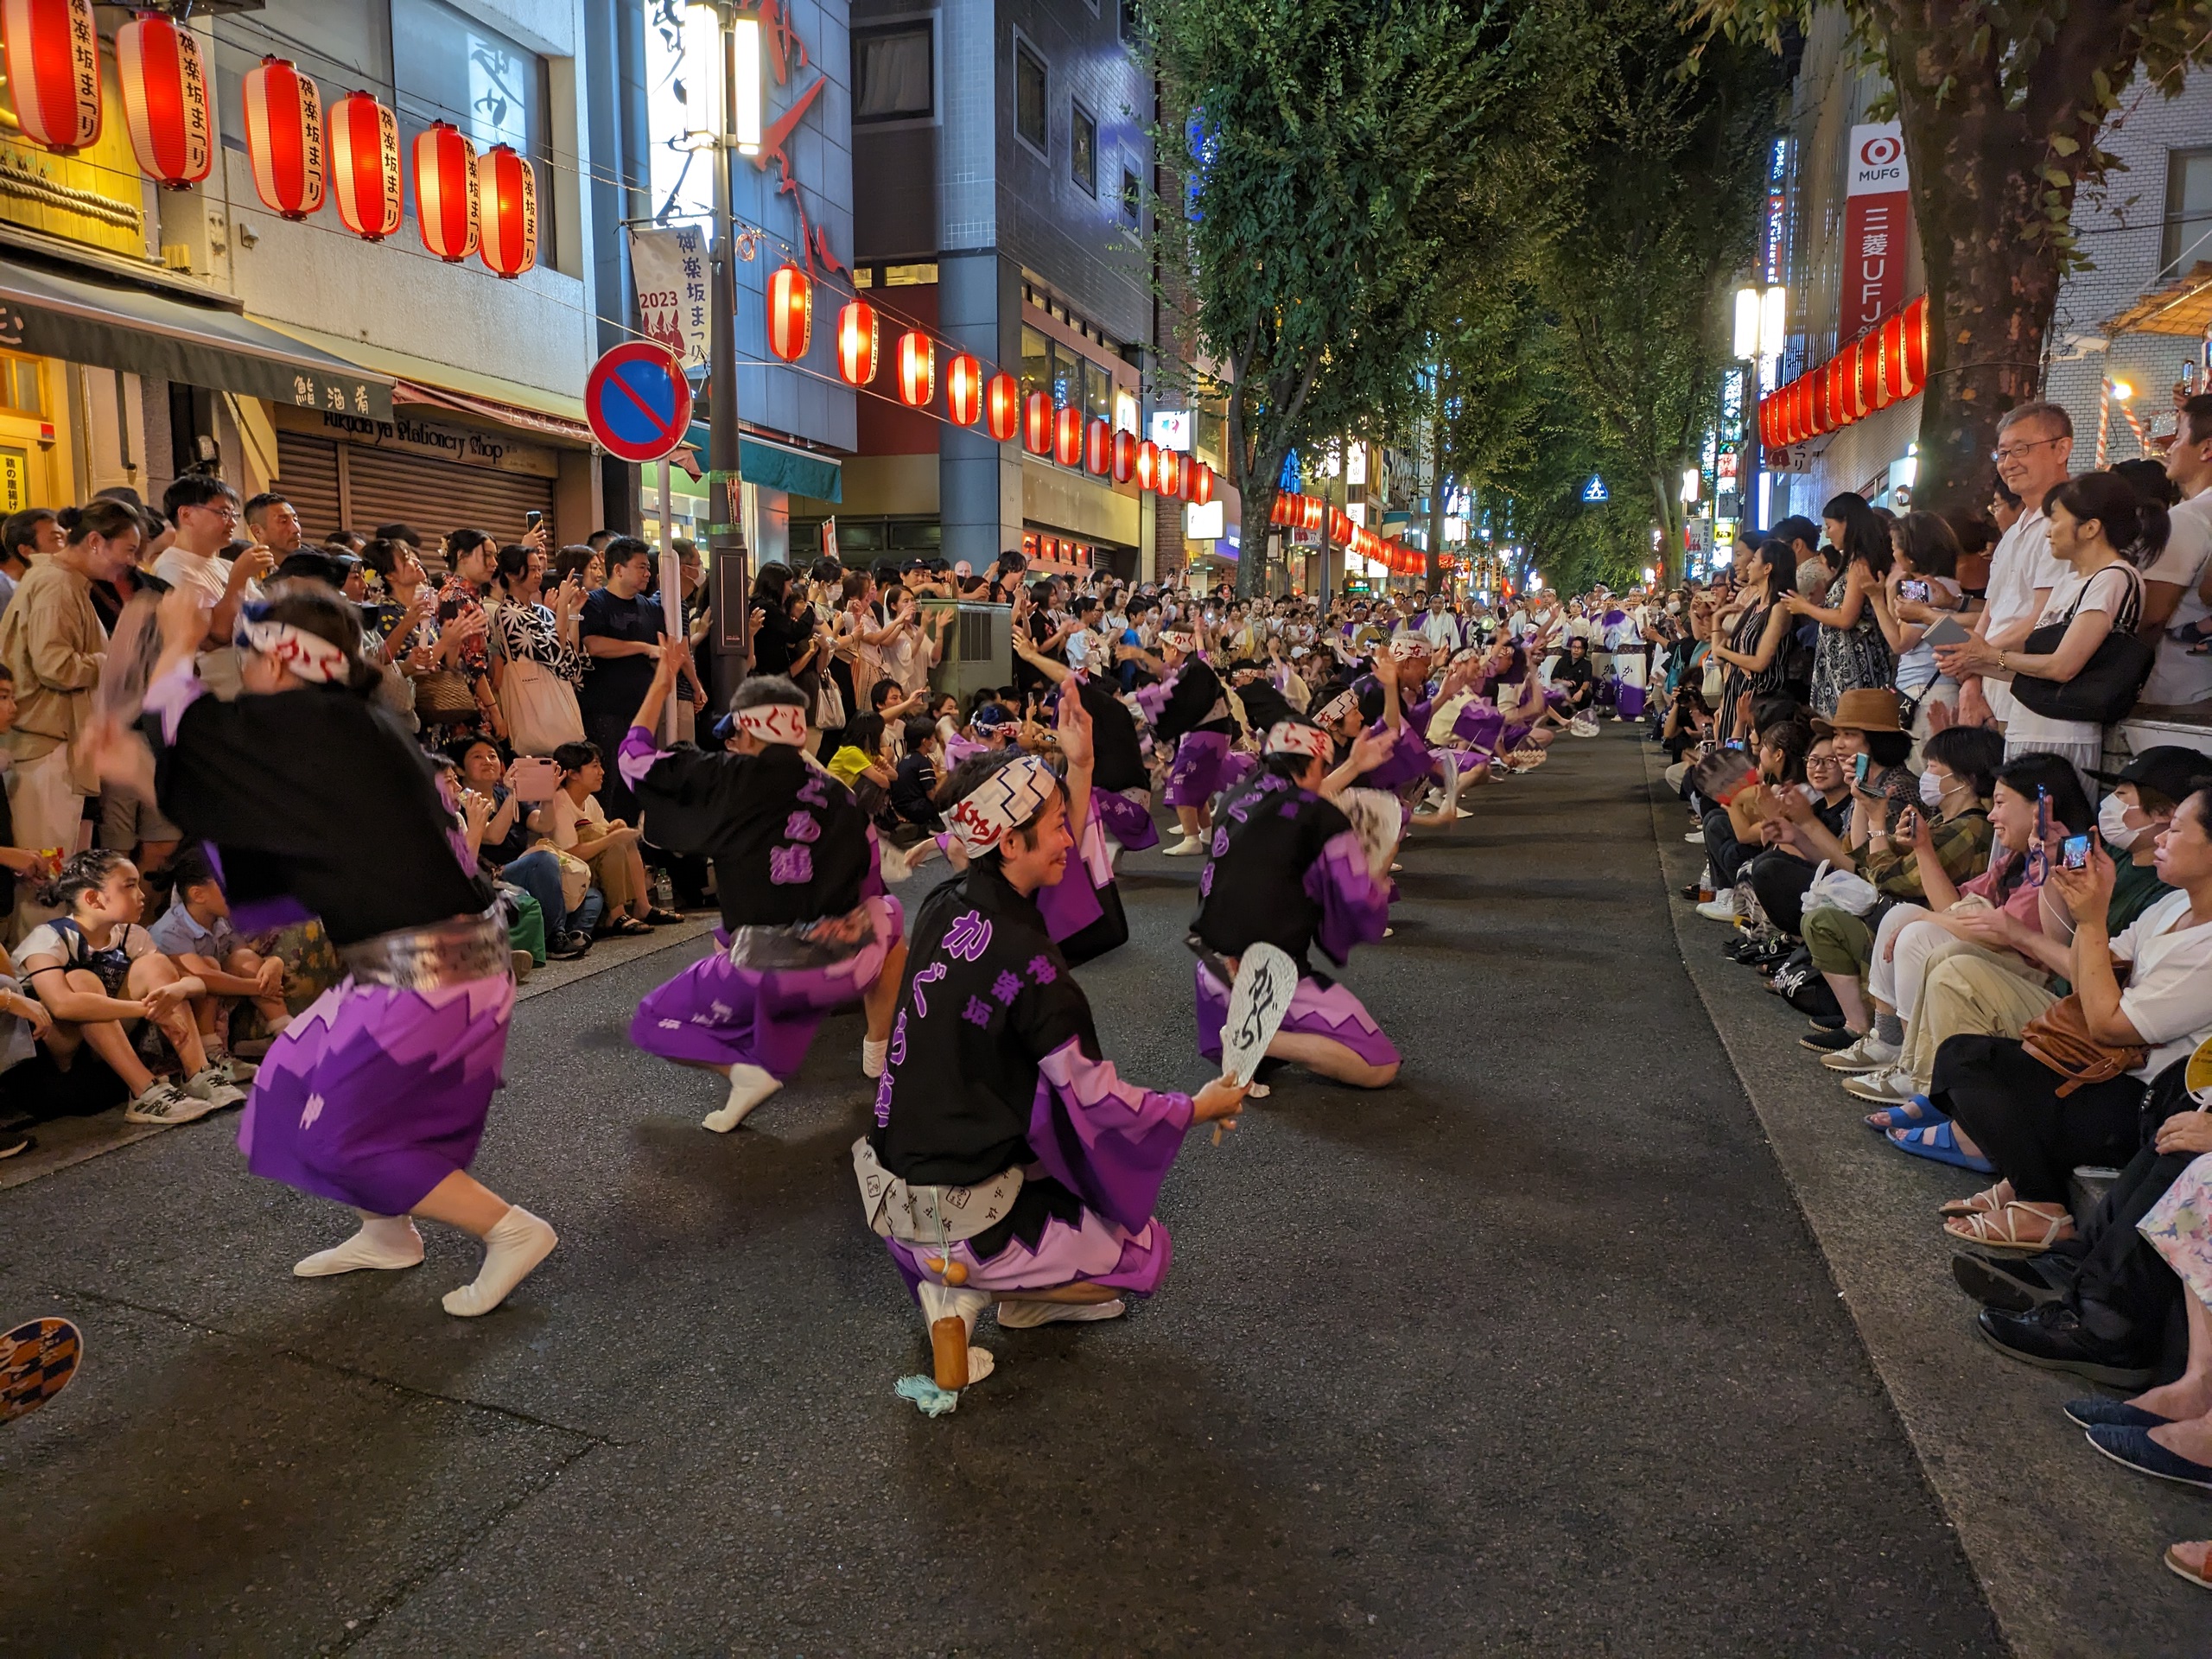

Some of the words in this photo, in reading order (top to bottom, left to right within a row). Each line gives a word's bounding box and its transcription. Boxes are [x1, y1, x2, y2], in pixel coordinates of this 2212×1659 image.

[179, 32, 207, 168] 神楽坂まつり
[299, 77, 321, 201] 神楽坂まつり
[381, 110, 398, 226] 神楽坂まつり
[465, 140, 479, 249] 神楽坂まつり
[521, 162, 535, 264] 神楽坂まつり
[1859, 168, 1900, 182] MUFG
[639, 290, 678, 308] 2023
[677, 231, 708, 364] 神楽坂まつり
[5, 458, 18, 512] 鶏の唐揚げ
[398, 422, 465, 459] Stationery
[470, 436, 503, 463] Shop
[739, 705, 807, 737] かぐら
